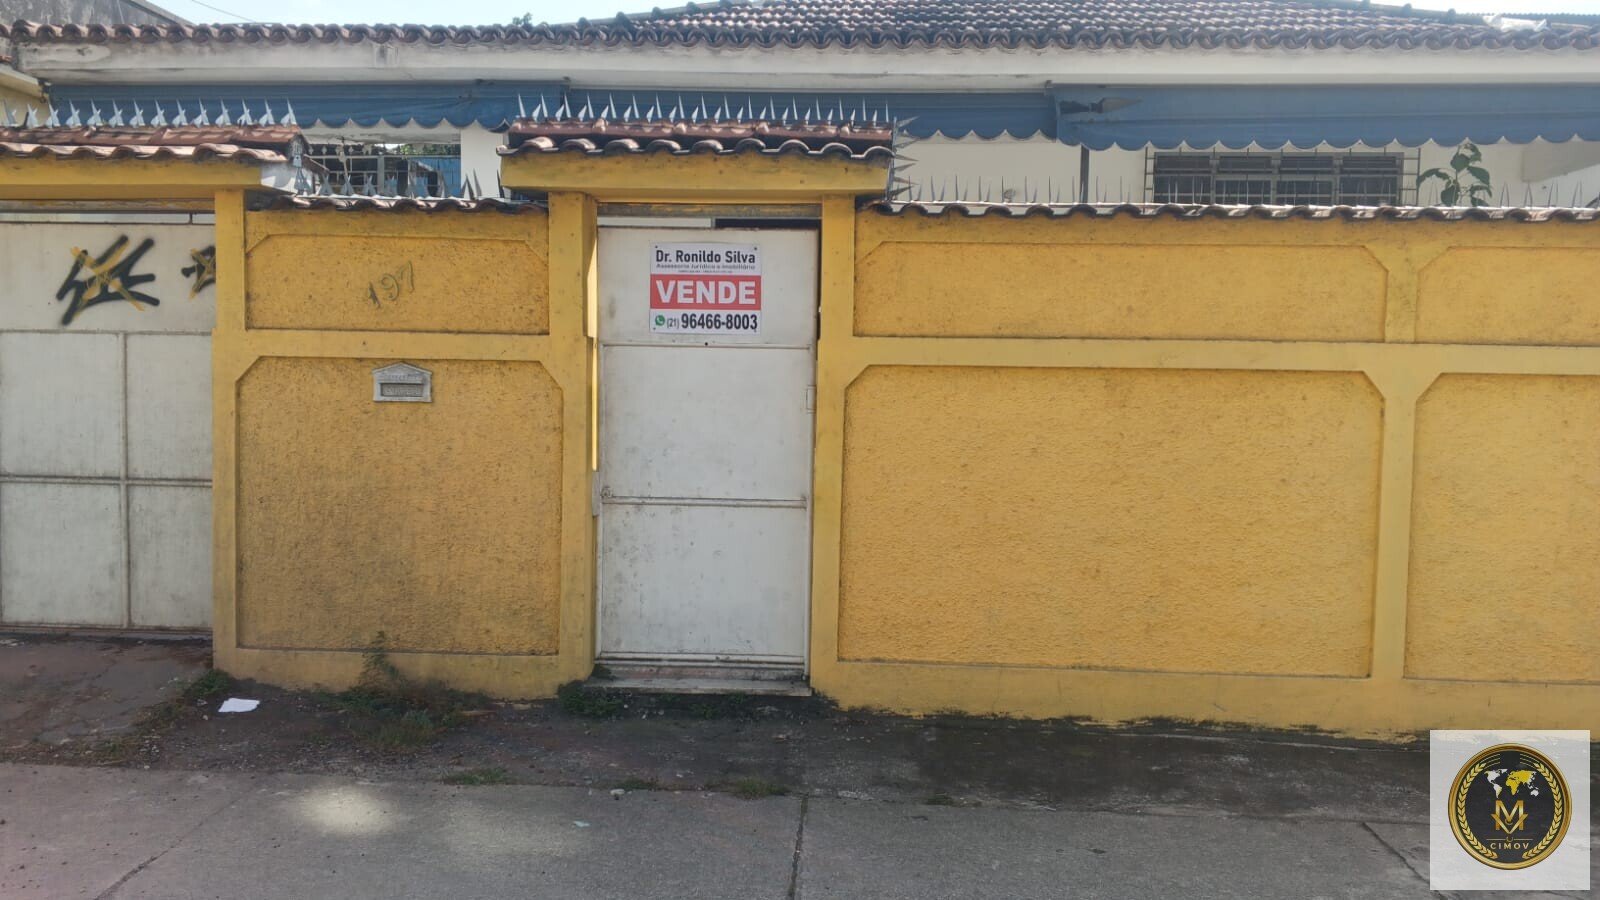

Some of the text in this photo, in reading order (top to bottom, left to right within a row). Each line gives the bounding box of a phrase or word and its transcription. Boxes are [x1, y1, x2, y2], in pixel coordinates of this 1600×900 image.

[656, 250, 755, 263] Dr. Ronildo Silva
[368, 261, 415, 309] 197
[655, 280, 756, 305] VENDE
[666, 313, 758, 330] (21) 96466-8003
